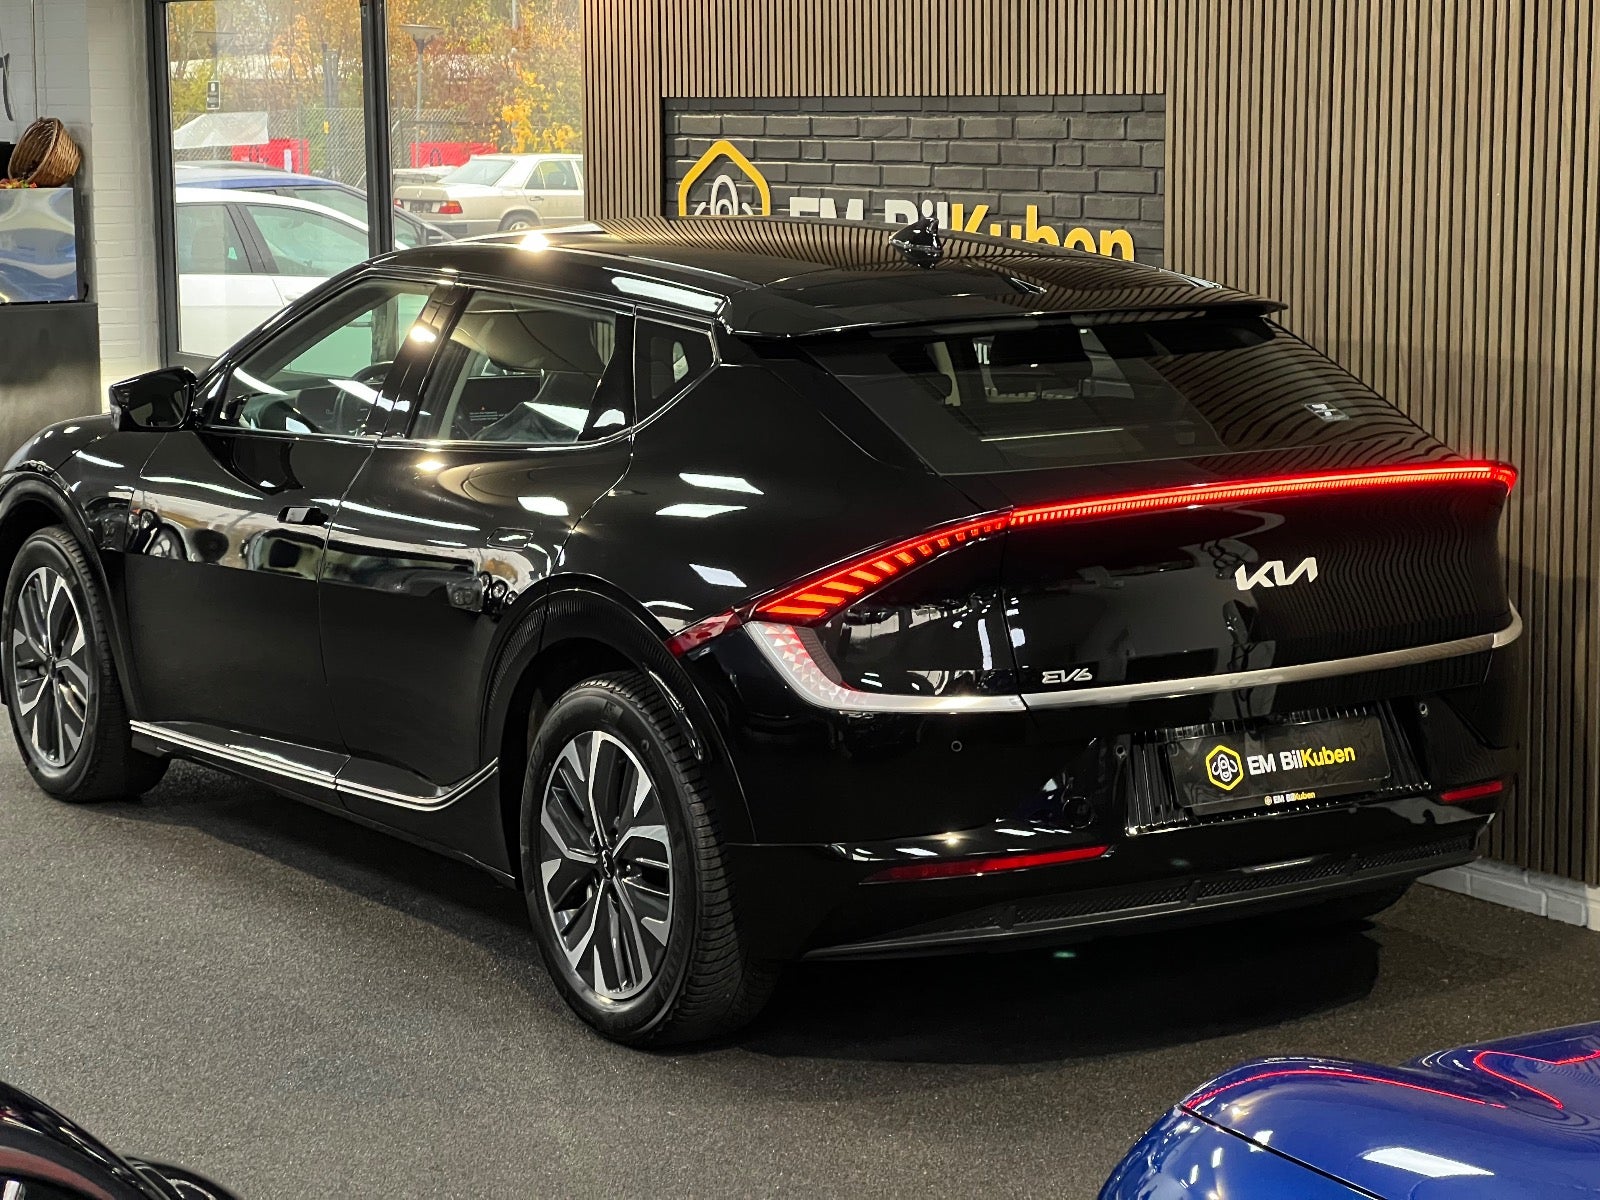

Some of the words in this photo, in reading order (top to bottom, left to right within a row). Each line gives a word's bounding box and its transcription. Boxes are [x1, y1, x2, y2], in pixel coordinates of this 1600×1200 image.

[1235, 557, 1318, 590] KIA
[1042, 668, 1092, 684] EV6
[1247, 753, 1277, 775] EM
[1280, 746, 1356, 770] BilKuben
[1273, 795, 1285, 804] EM
